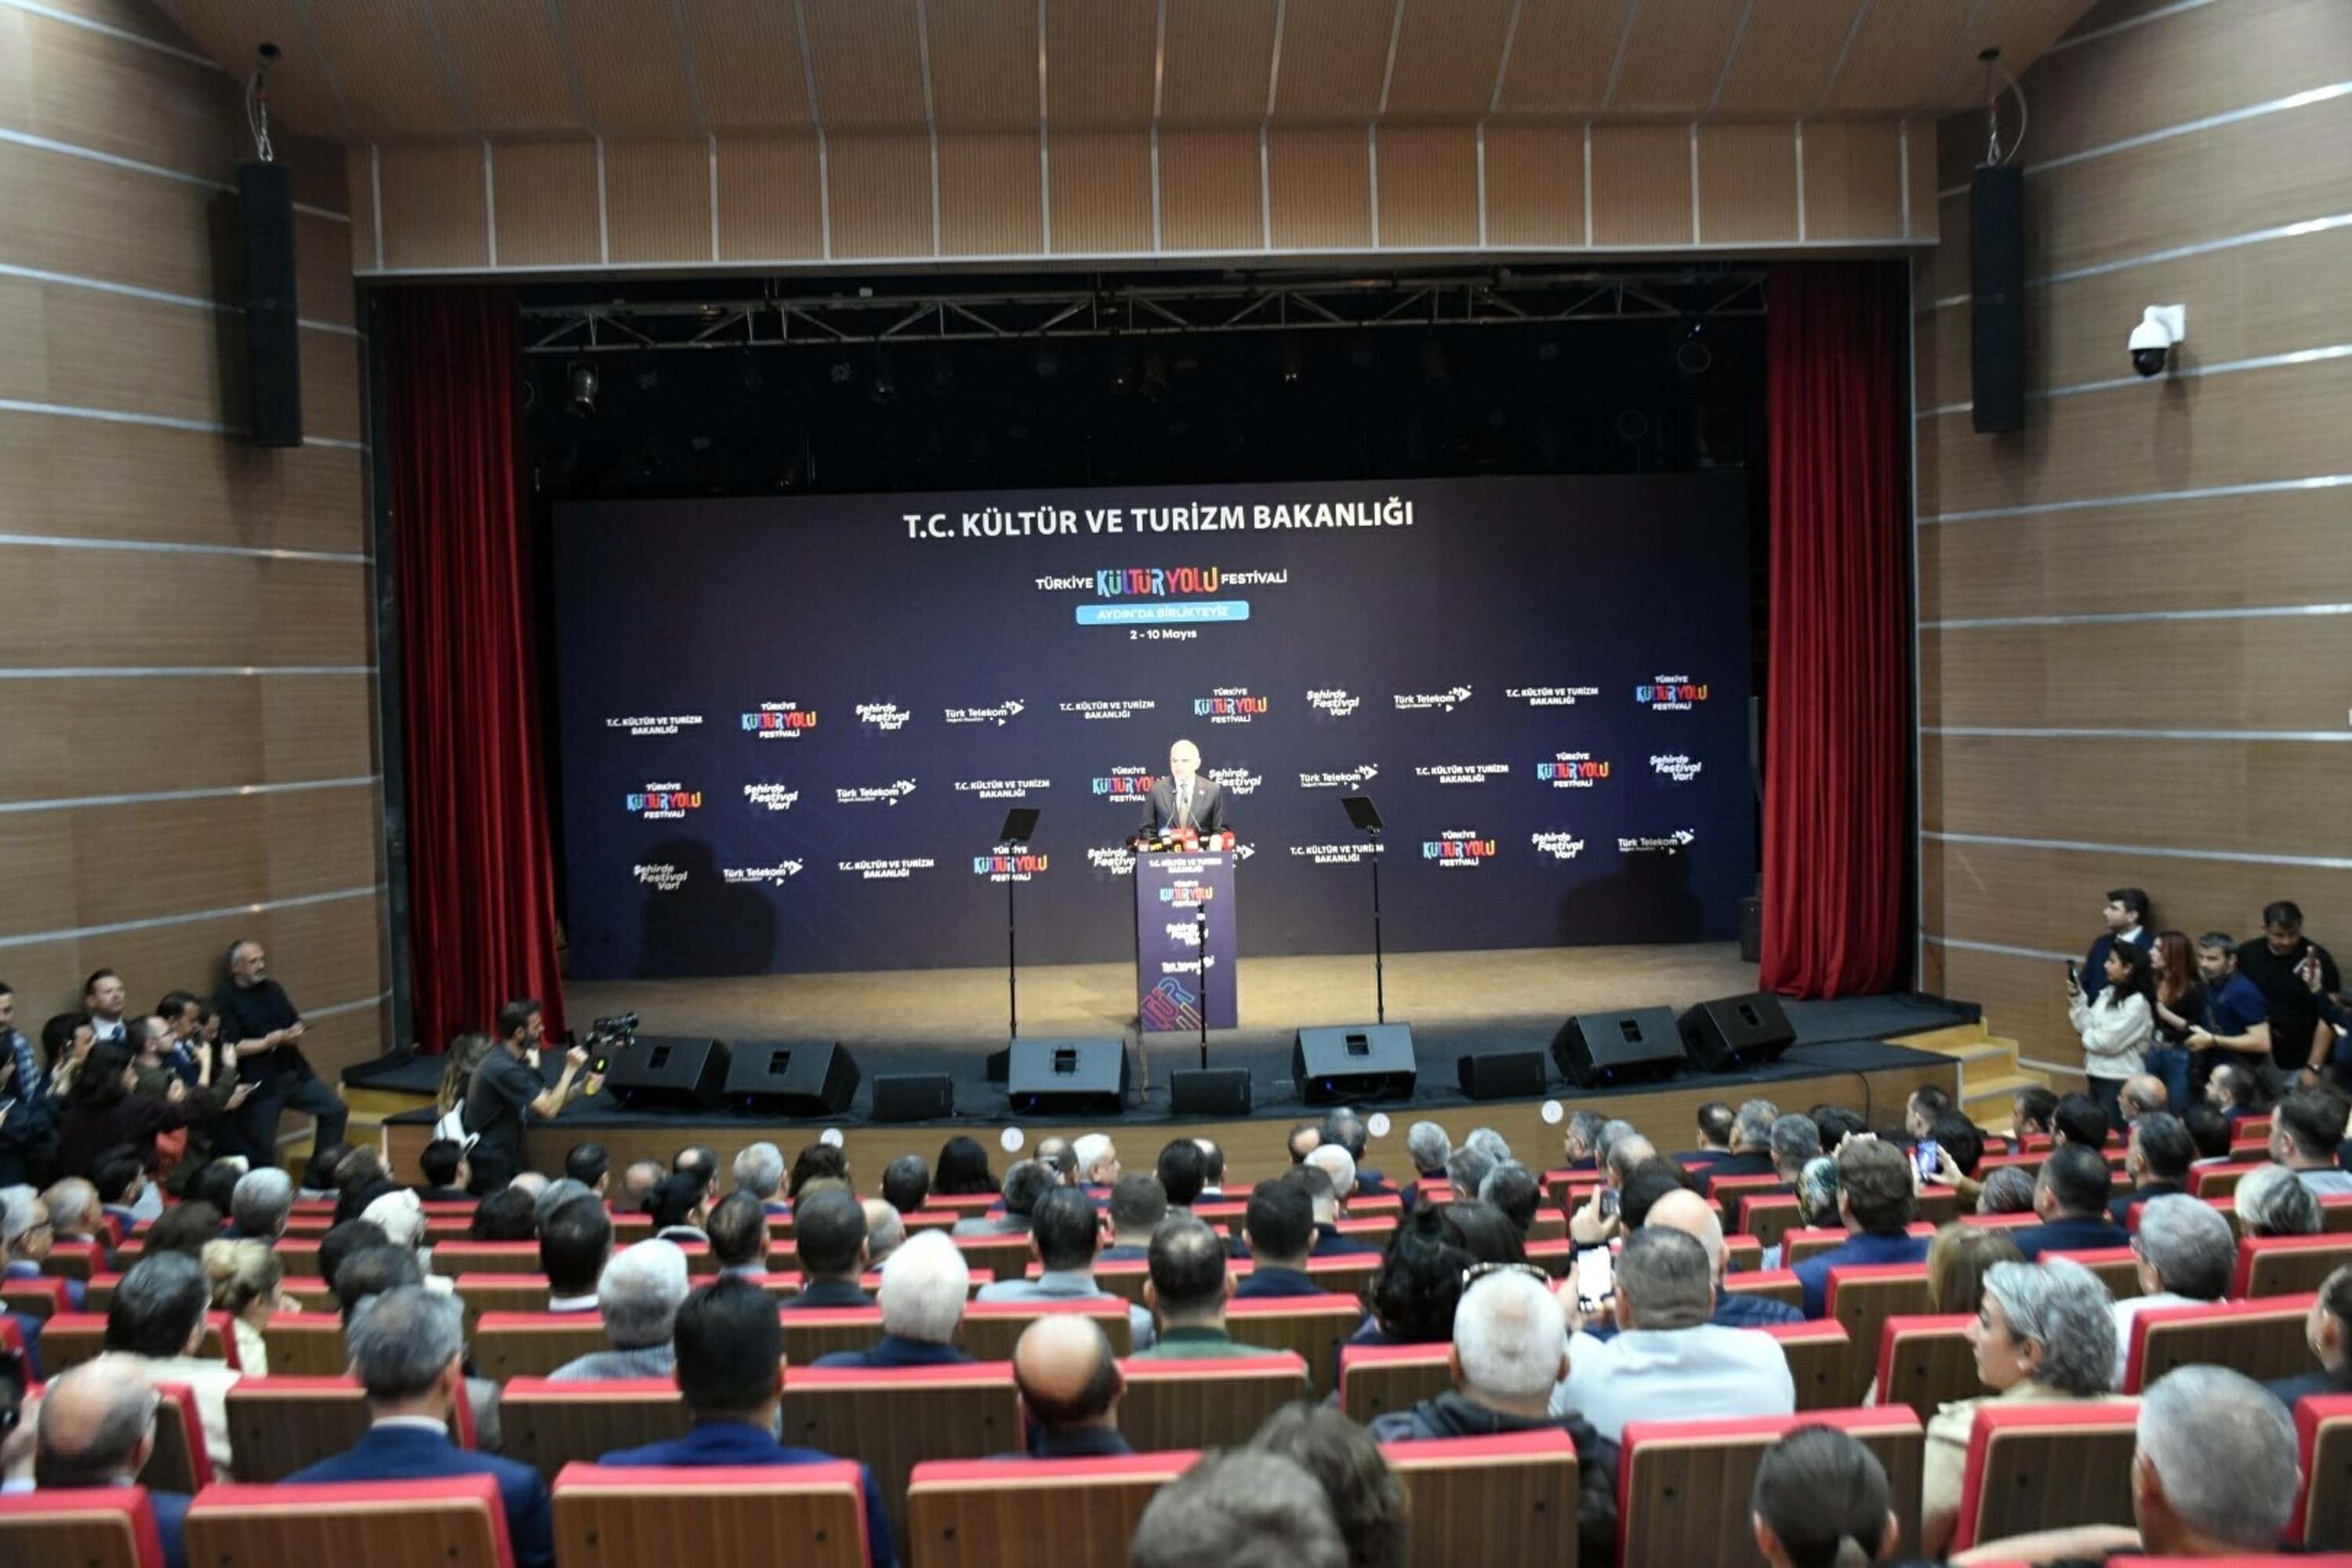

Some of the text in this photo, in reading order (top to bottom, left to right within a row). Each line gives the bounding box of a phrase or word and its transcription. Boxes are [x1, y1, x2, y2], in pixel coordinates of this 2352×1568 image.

[902, 496, 1414, 539] T.C. KÜLTÜR VE TURİZM BAKANLIĞI
[1035, 567, 1288, 597] TÜRKİYE KÜLTÜR YOLU FESTİVALİ
[1157, 604, 1229, 618] BİRLİKTEYİZ
[1130, 630, 1138, 640] 2
[1146, 630, 1160, 640] 10
[1162, 629, 1198, 641] Mayıs
[1676, 684, 1708, 701] YOLU
[1110, 701, 1122, 710] VE
[1236, 696, 1268, 713] YOLU
[1394, 695, 1455, 706] Türk Telekom
[945, 707, 1007, 718] Türk Telekom
[657, 717, 669, 725] VE
[784, 710, 818, 728] YOLU
[1464, 765, 1476, 774] VE
[1578, 761, 1610, 779] YOLU
[1134, 776, 1155, 793] YO
[1300, 773, 1361, 784] Türk Telekom
[836, 787, 899, 799] Türk Telekom
[1109, 793, 1146, 803] FESTİVAL
[669, 792, 702, 809] YOLU
[1465, 840, 1497, 857] YOLU
[1617, 837, 1679, 848] Türk Telekom
[1339, 845, 1352, 854] VE
[889, 860, 902, 869] VE
[1015, 855, 1048, 872] YOLU
[1094, 856, 1136, 867] Festiva
[723, 867, 786, 879] Türk Telekom
[991, 873, 1032, 882] FESTVALİ
